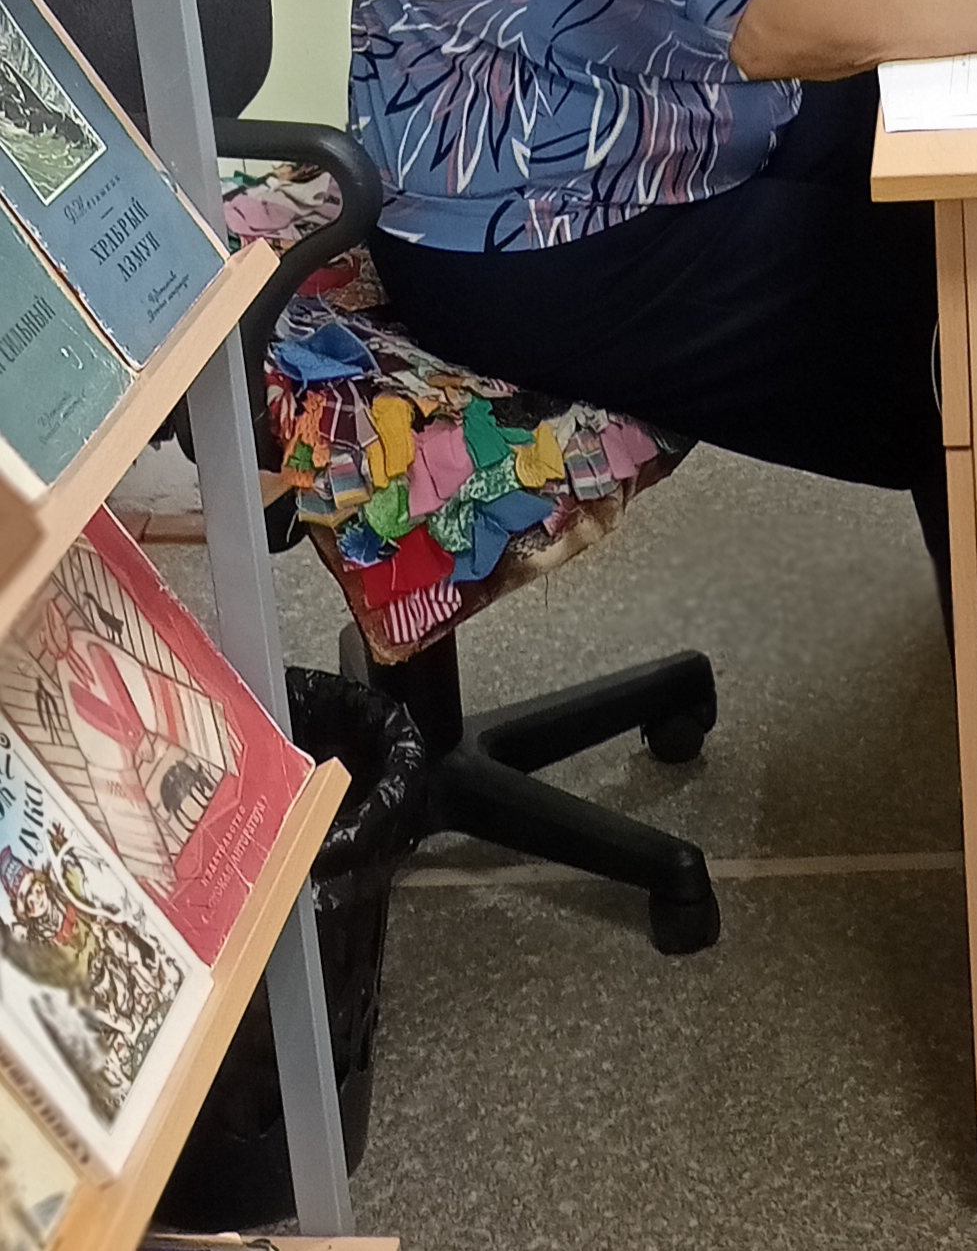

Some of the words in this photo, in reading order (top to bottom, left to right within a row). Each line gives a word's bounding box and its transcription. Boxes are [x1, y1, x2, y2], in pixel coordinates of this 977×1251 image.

[90, 196, 149, 265] ХРАБРЫЙ
[117, 230, 161, 283] АЗМУН
[0, 295, 56, 363] СИЛЬНЫЙ
